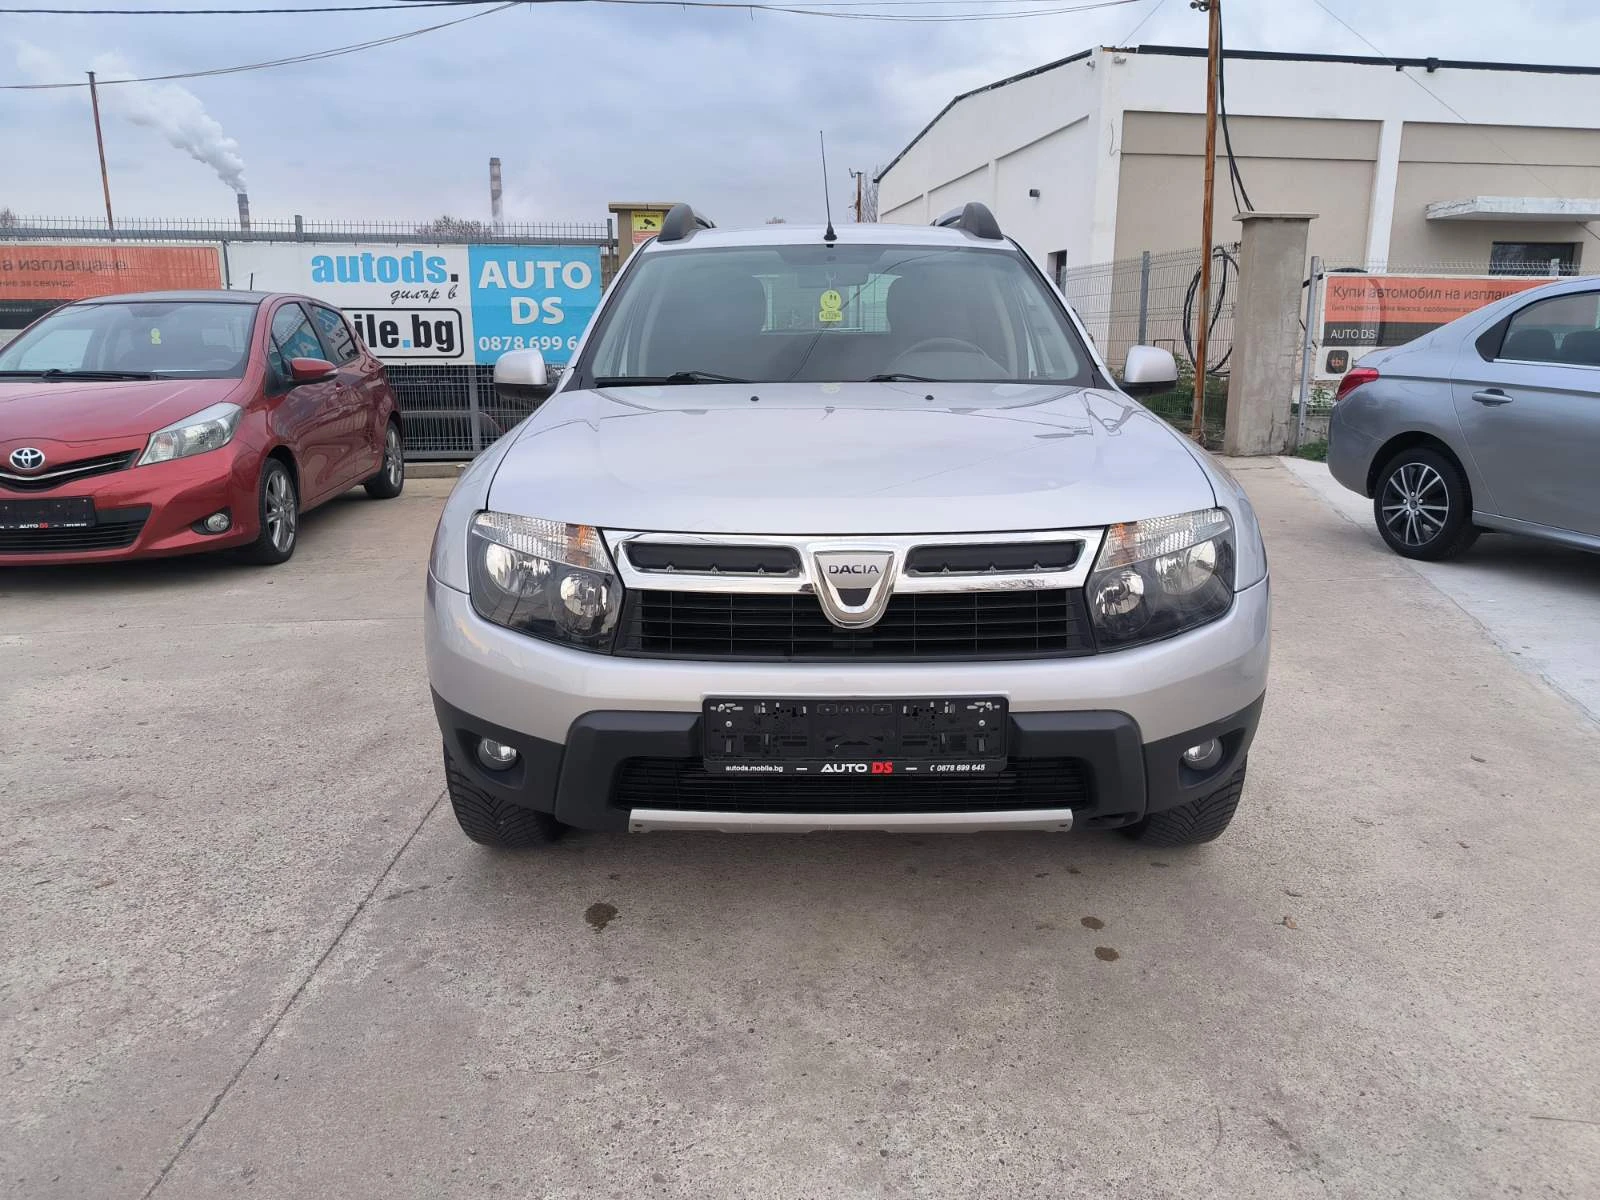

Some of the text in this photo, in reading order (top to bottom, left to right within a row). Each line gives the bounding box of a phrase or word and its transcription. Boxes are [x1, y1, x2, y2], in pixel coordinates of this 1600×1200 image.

[312, 251, 458, 284] autods.
[478, 260, 592, 289] AUTO
[390, 288, 440, 304] дилър
[1333, 287, 1366, 300] Купи
[1369, 286, 1441, 299] автомобил
[1445, 290, 1460, 299] на
[510, 297, 565, 325] DS
[353, 314, 455, 353] ile.bg
[1331, 329, 1375, 339] AUTO DS
[478, 336, 579, 351] 0878 699 6
[828, 564, 879, 574] DACIA
[820, 763, 867, 773] AUTO
[872, 762, 893, 774] DS
